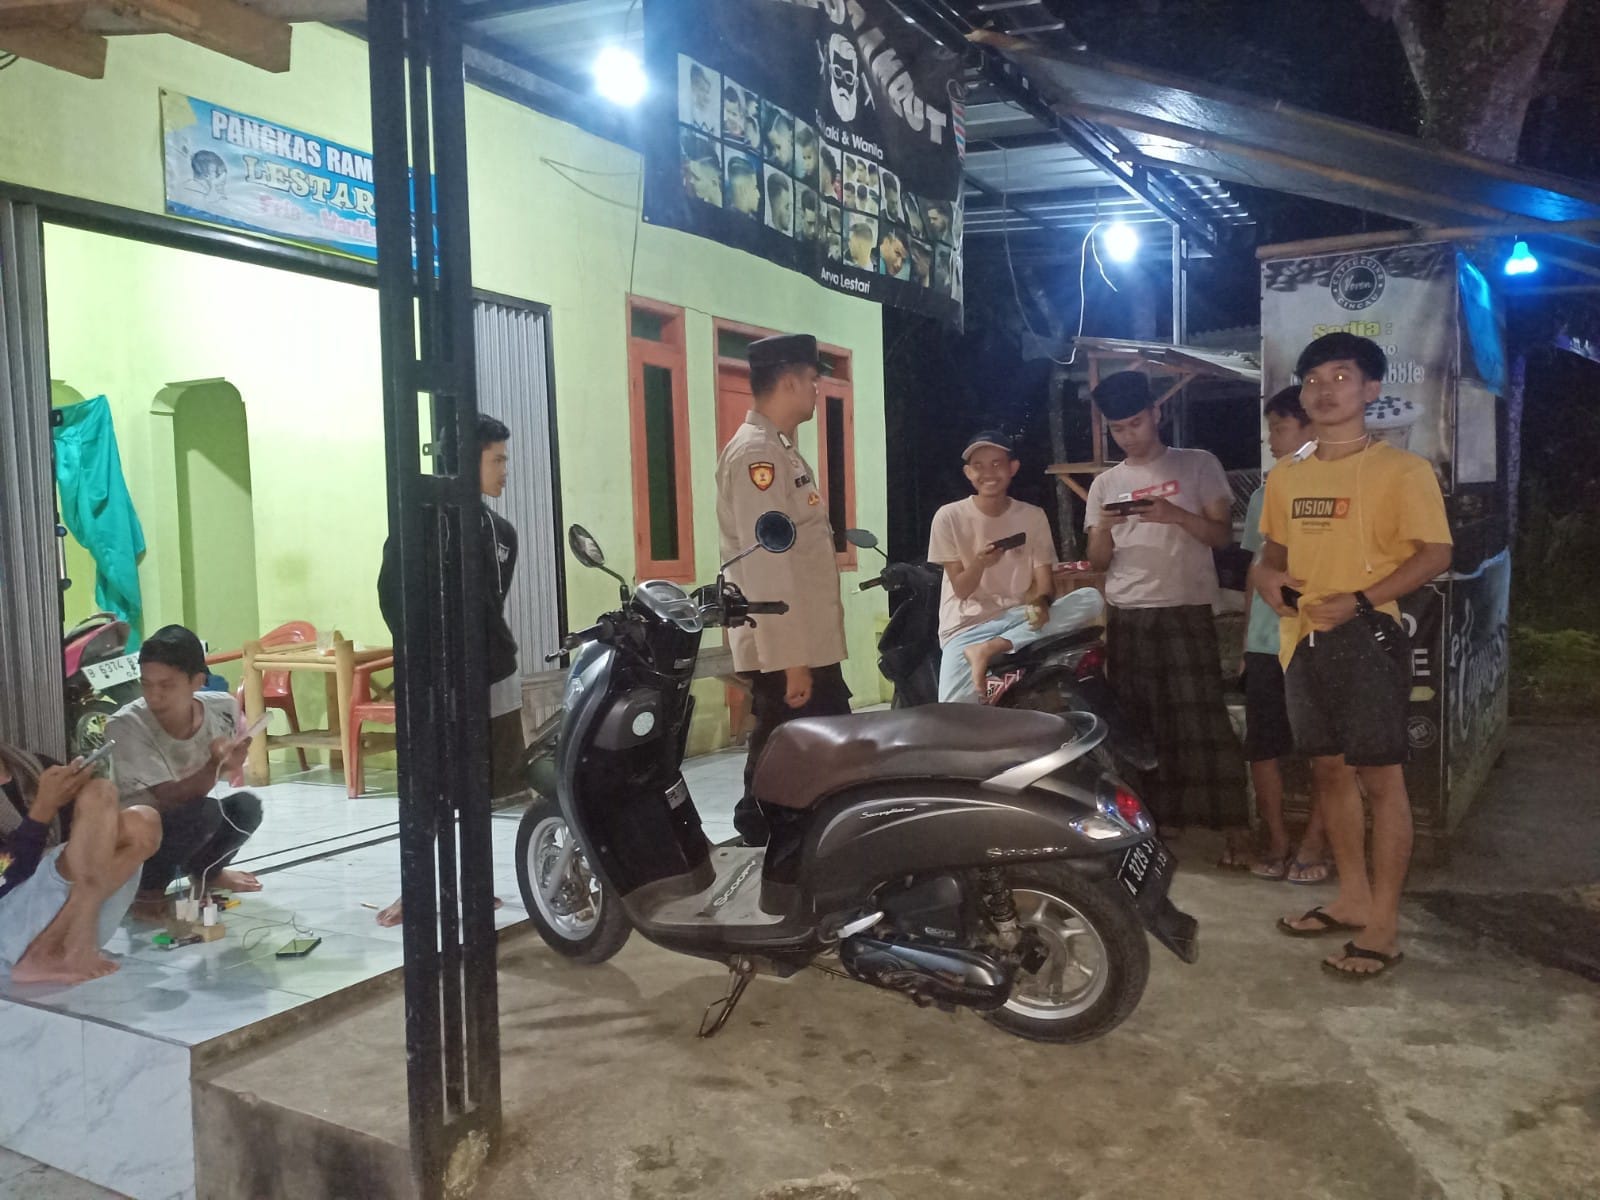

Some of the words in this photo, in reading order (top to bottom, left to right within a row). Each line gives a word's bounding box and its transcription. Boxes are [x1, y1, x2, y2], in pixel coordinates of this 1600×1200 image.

[211, 109, 322, 169] PANGKAS
[326, 145, 374, 183] RAM
[841, 130, 850, 146] &
[243, 154, 377, 217] LESTAR
[840, 273, 871, 294] Lestari
[1294, 499, 1335, 517] VISION
